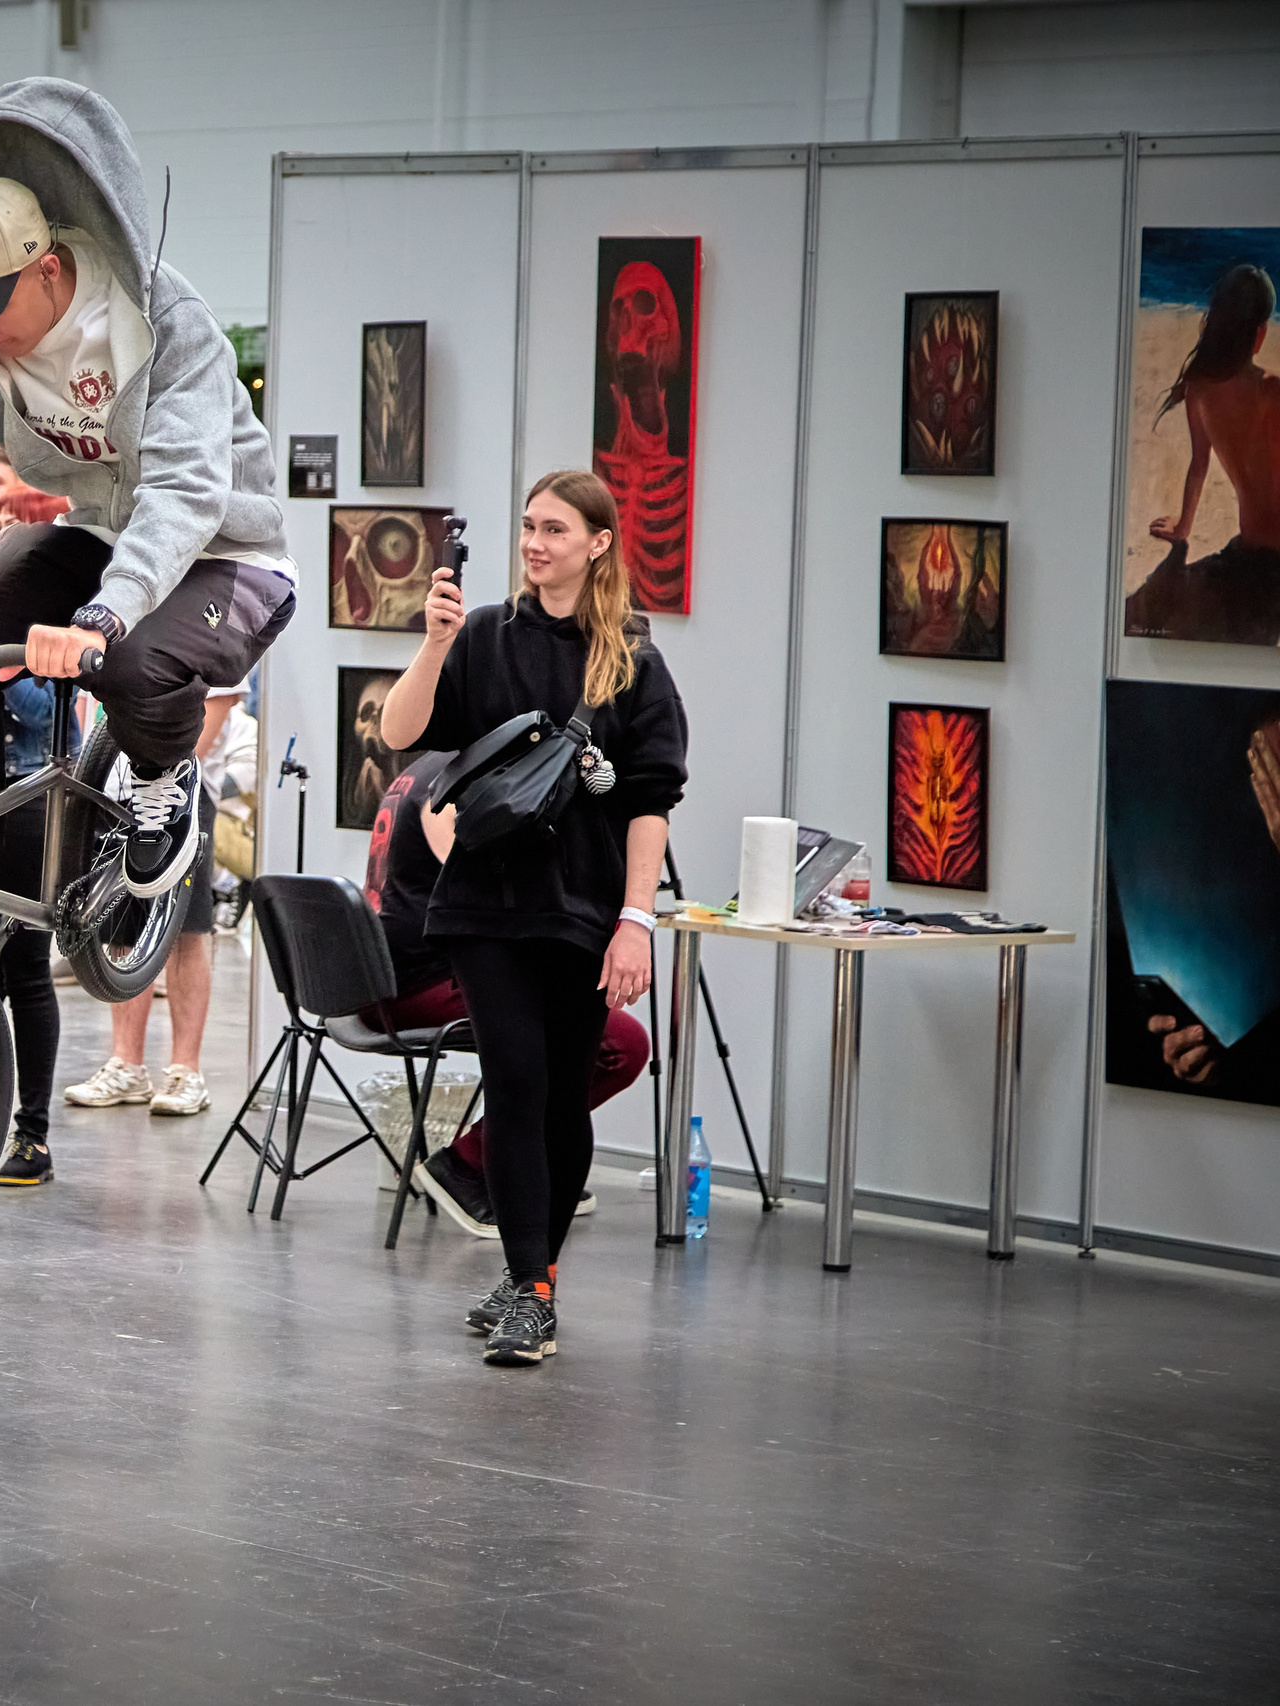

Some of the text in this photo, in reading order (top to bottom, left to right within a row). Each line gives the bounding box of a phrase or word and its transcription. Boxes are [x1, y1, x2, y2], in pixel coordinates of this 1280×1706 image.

[46, 414, 56, 428] of
[59, 416, 75, 428] the
[78, 416, 105, 433] Gam
